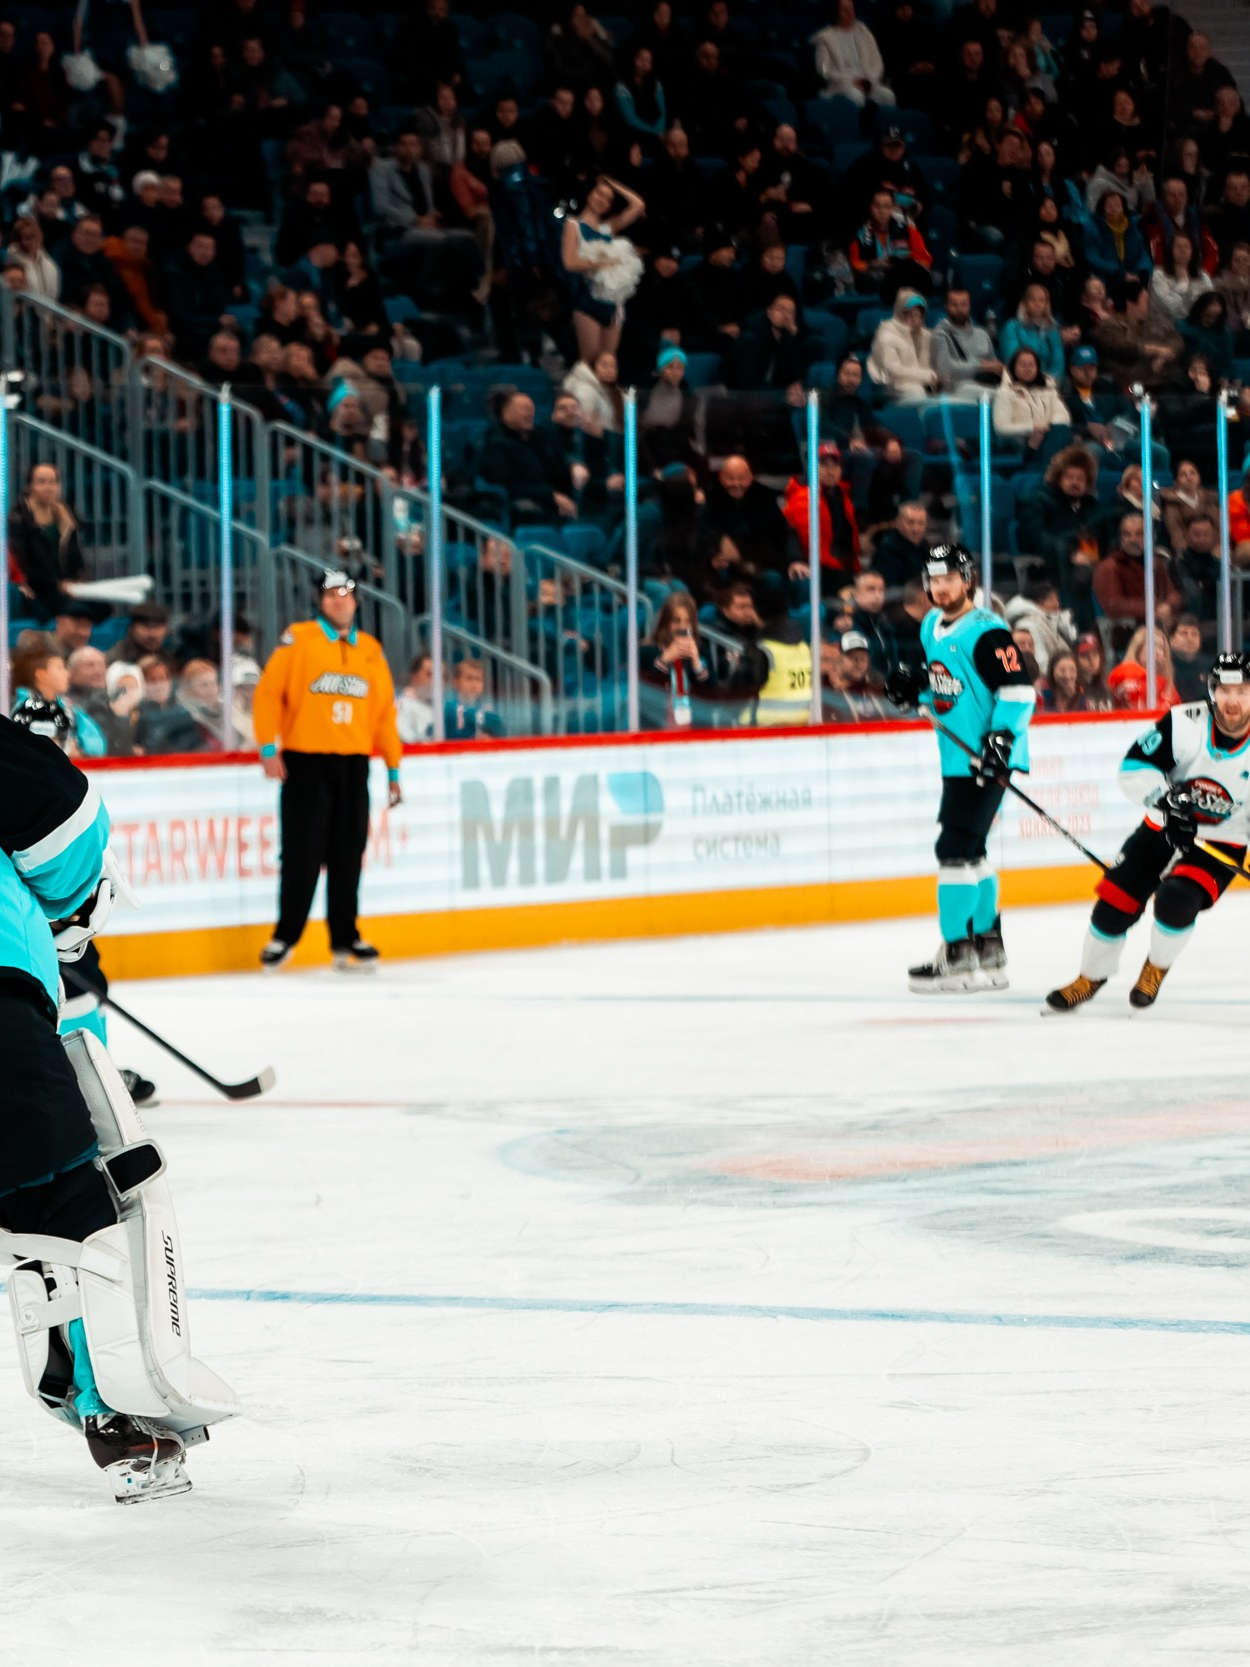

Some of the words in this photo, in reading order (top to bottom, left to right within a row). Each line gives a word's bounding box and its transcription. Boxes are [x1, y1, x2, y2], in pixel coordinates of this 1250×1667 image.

[995, 645, 1022, 674] 72
[110, 814, 281, 888] TARWEE
[459, 770, 665, 891] МИР
[692, 831, 781, 861] система
[161, 1229, 182, 1338] SUPREME
